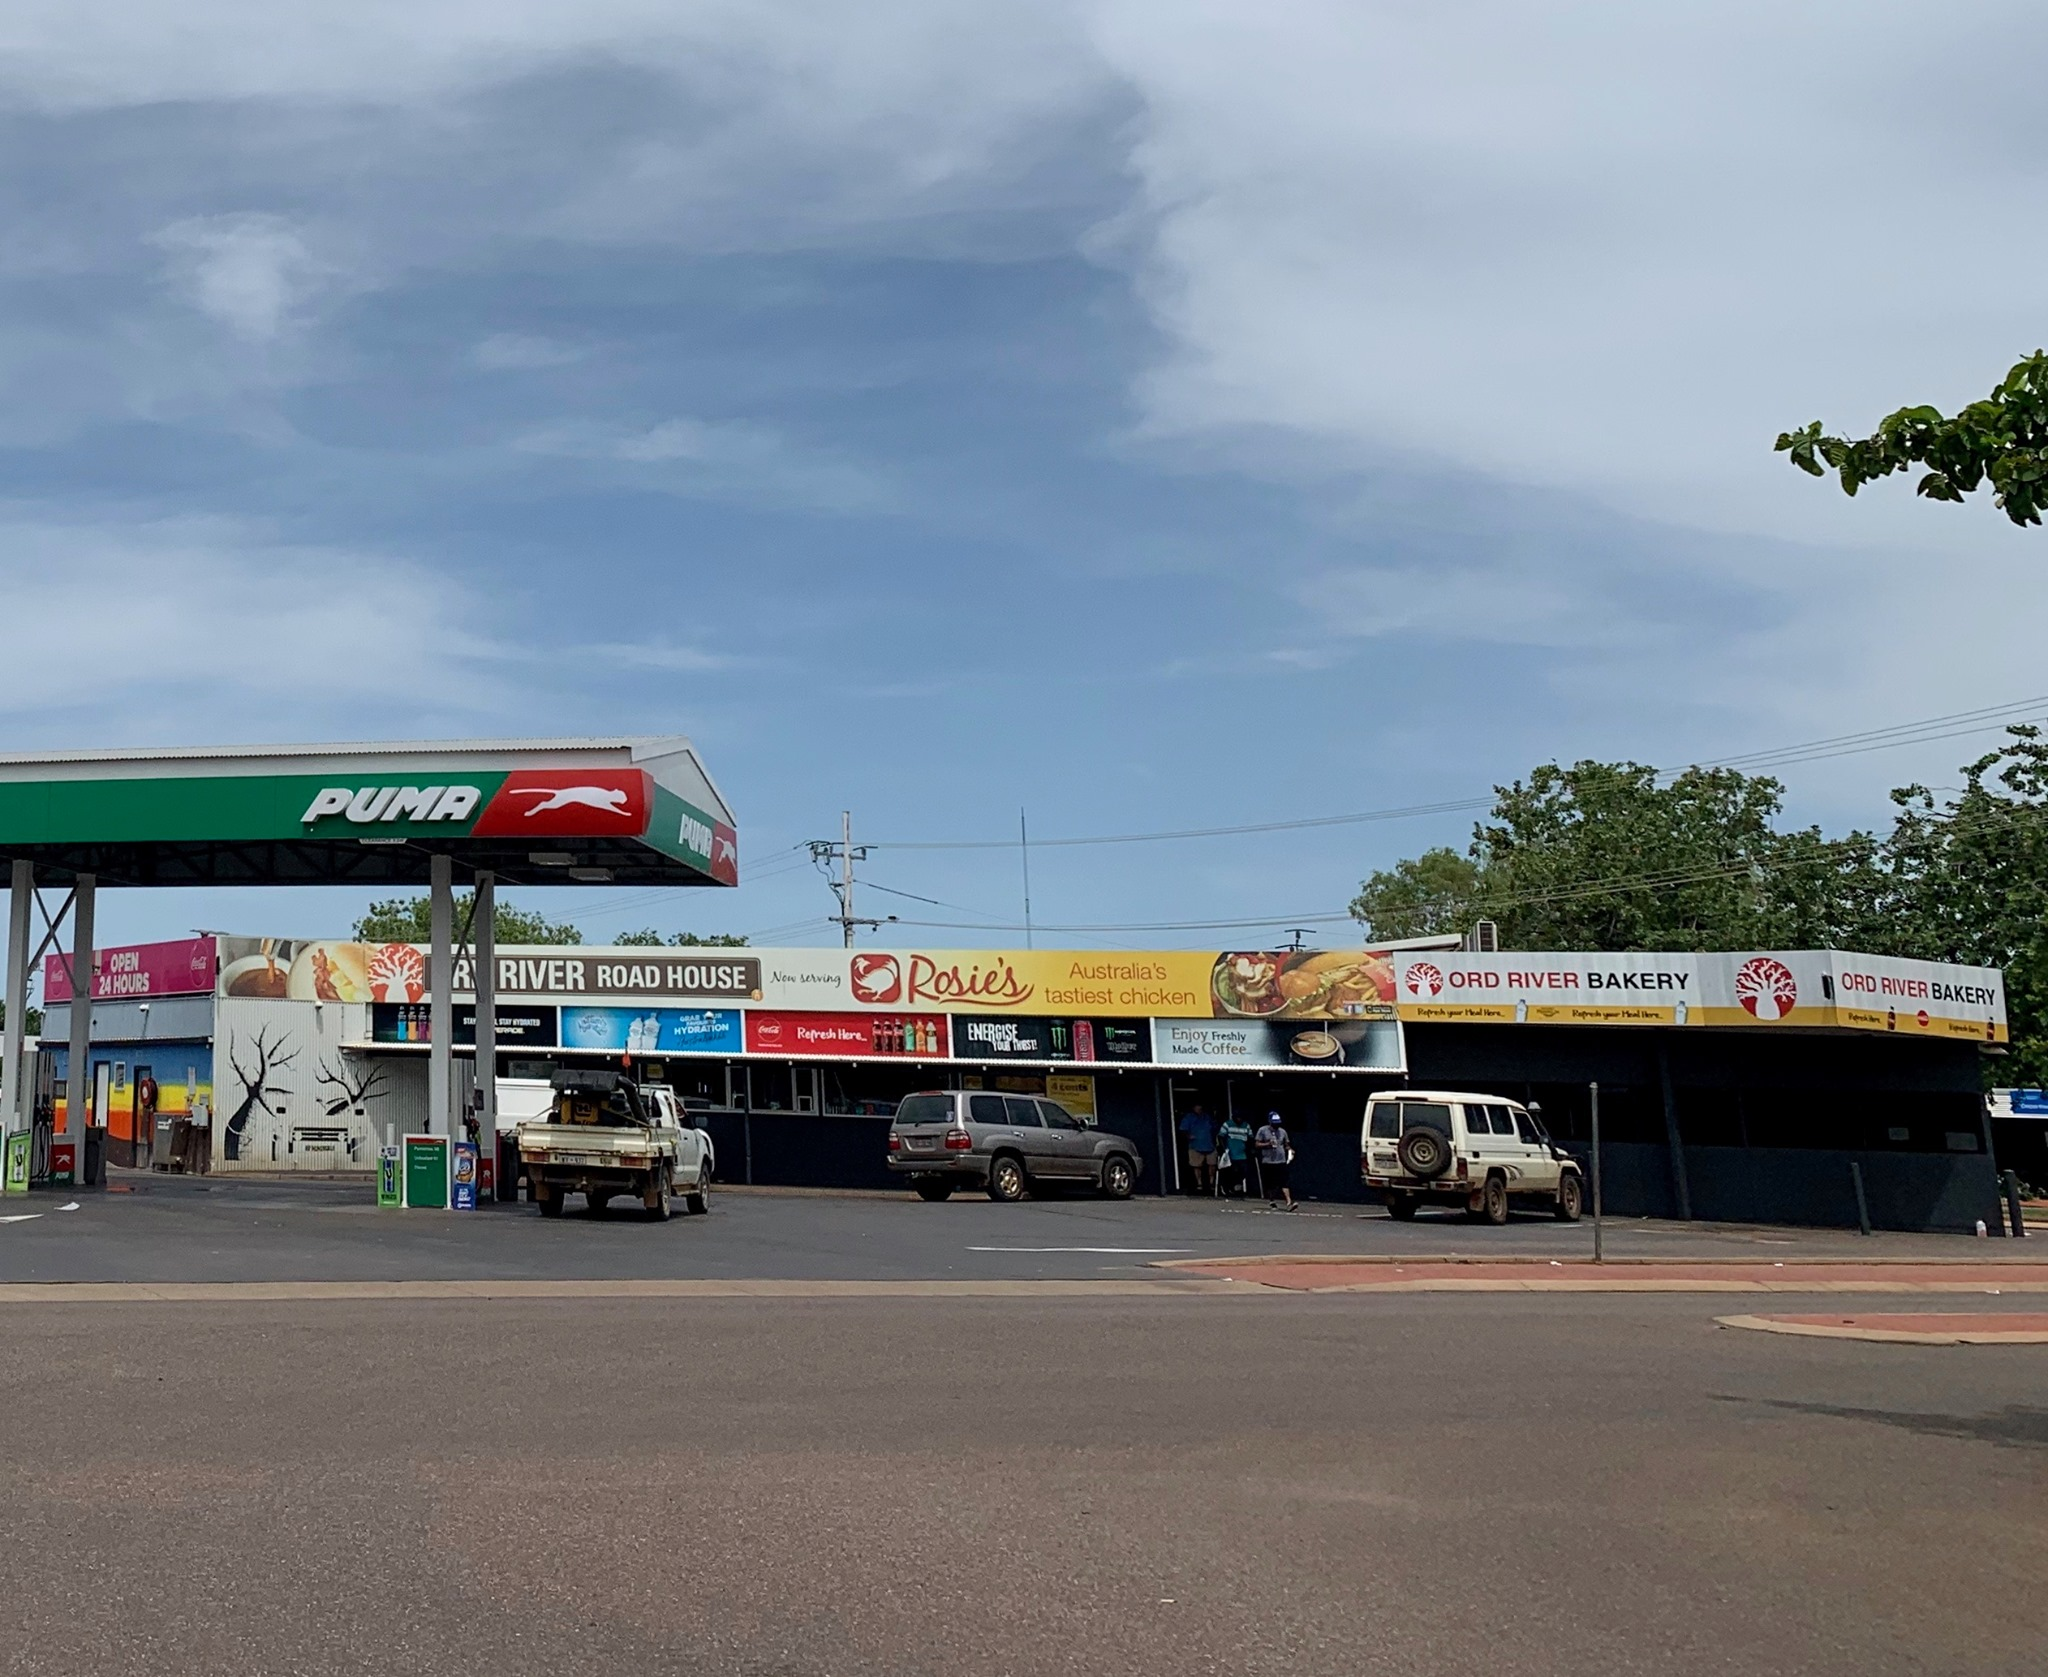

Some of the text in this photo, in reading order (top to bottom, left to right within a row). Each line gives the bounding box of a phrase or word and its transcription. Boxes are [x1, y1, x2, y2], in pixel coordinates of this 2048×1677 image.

[300, 785, 482, 823] PUMA
[678, 812, 714, 859] PUMA
[110, 952, 139, 973] OPEN
[1069, 962, 1167, 980] Australia's
[99, 972, 149, 995] 24 HOURS
[499, 959, 586, 990] RIVER
[597, 964, 660, 988] ROAD
[667, 965, 747, 989] HOUSE
[770, 970, 841, 988] Now serving
[908, 954, 1035, 1006] Rosie's
[1449, 972, 1689, 990] ORD RIVER BAKERY
[1044, 987, 1196, 1005] tastiest chicken
[1842, 972, 1995, 1006] ORD RIVER BAKERY
[463, 1017, 476, 1025] STAY
[499, 1018, 512, 1026] STAY
[1417, 1008, 1445, 1018] Refresh
[1572, 1009, 1601, 1019] Refresh
[674, 1023, 729, 1035] HYDRATION
[797, 1026, 836, 1043] Refresh
[967, 1023, 1018, 1042] ENERGISE
[1172, 1027, 1246, 1043] Enjoy Freshly
[992, 1040, 1011, 1051] YOUR
[1172, 1045, 1199, 1054] Made
